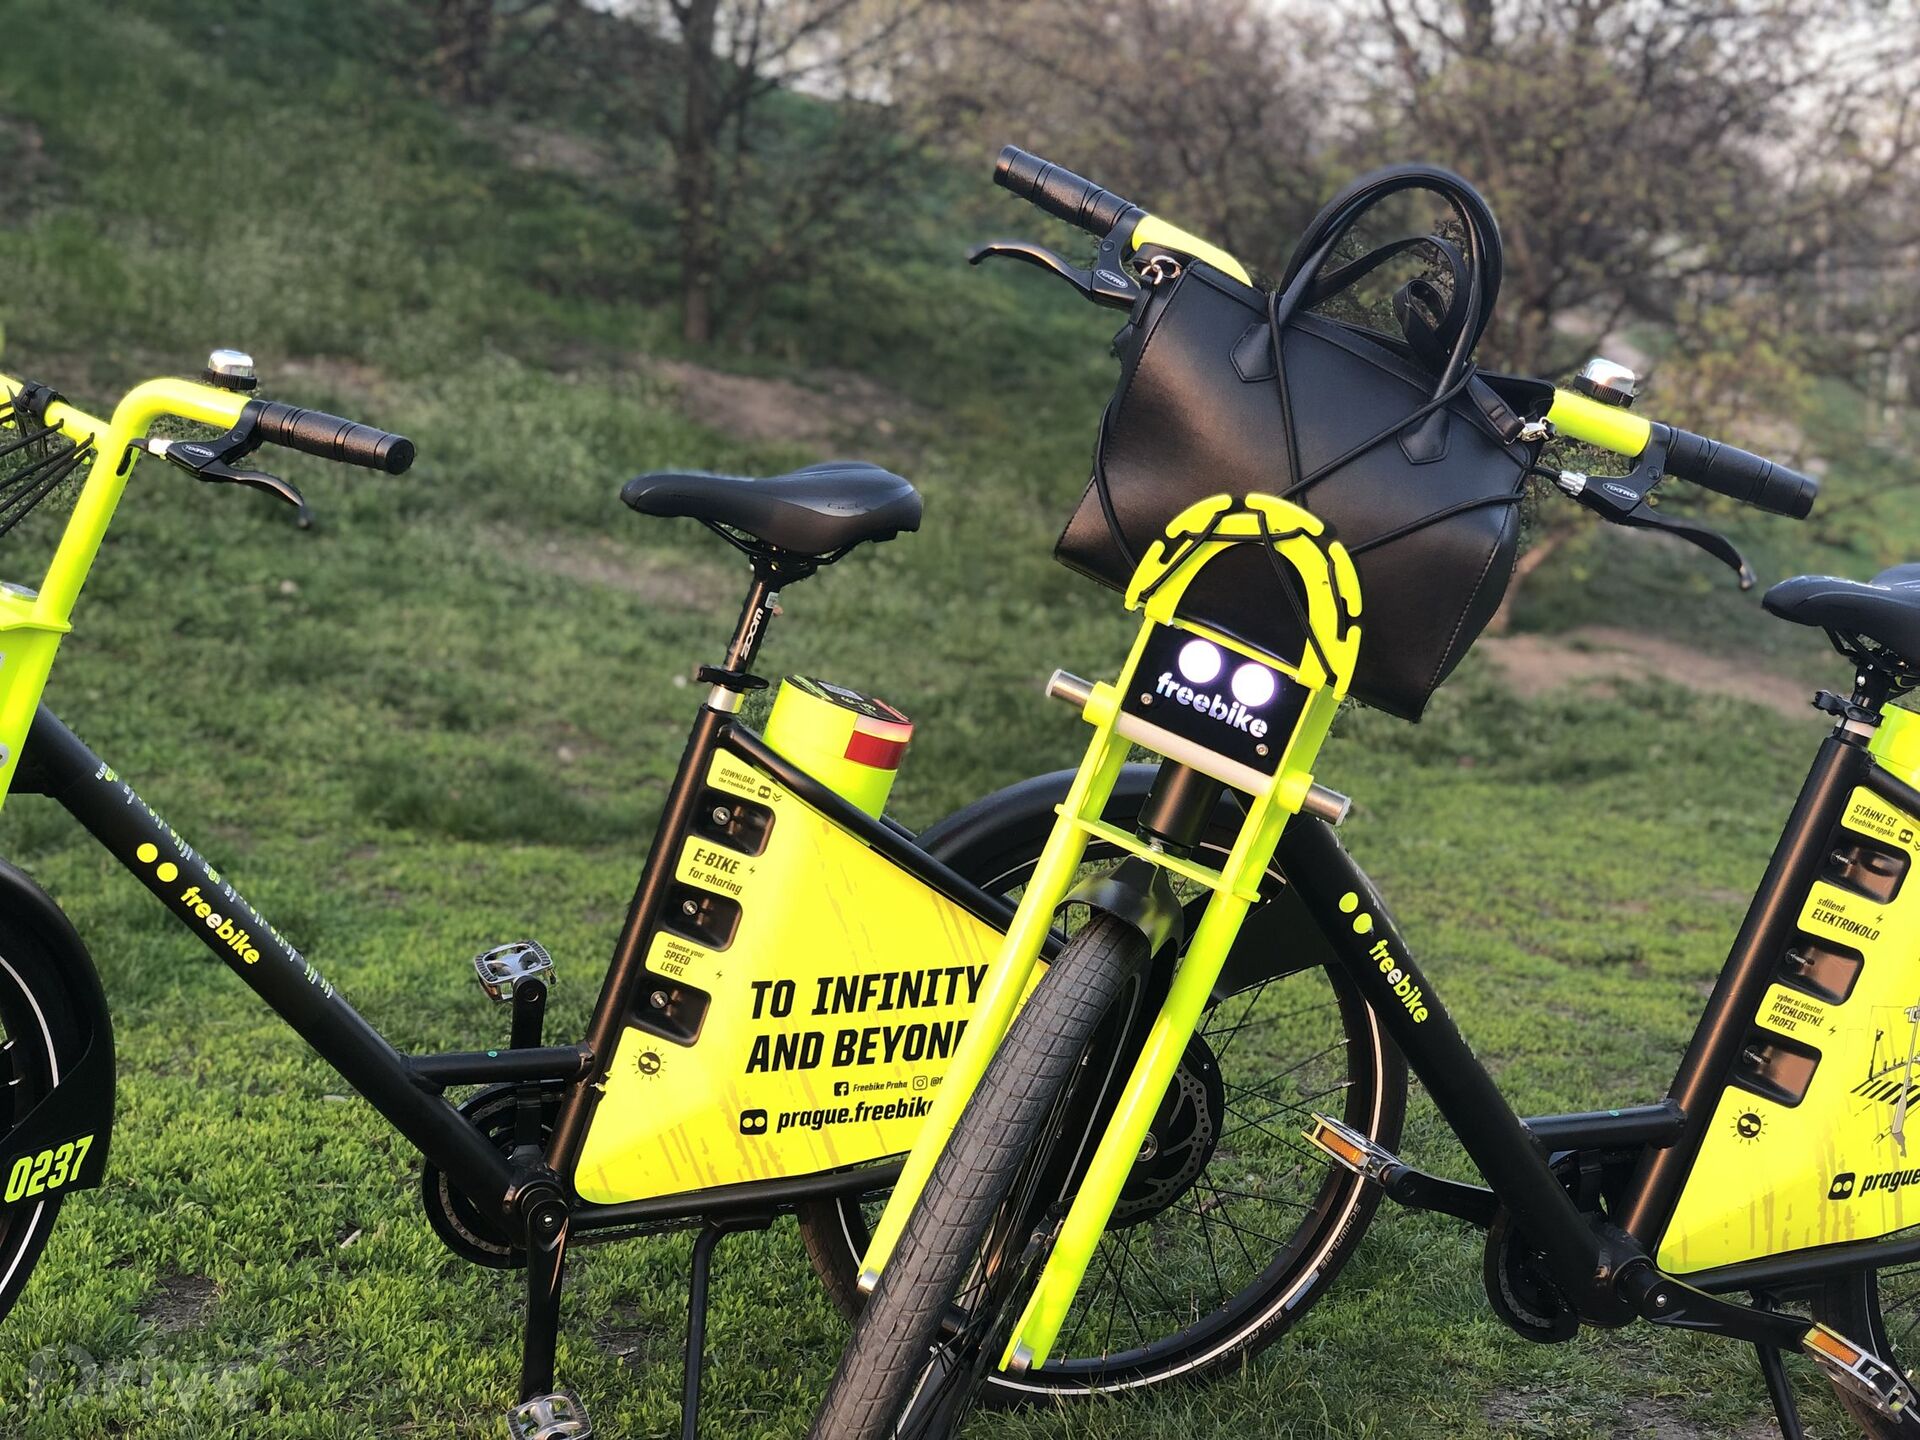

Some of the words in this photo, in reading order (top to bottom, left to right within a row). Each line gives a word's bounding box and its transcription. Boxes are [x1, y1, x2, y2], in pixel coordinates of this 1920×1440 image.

[1155, 672, 1268, 738] freebike
[720, 767, 755, 785] DOWNLOAD
[1849, 815, 1875, 829] freebike
[1885, 816, 1898, 827] SI
[693, 848, 740, 874] E-BIKE
[688, 867, 706, 880] for
[704, 874, 742, 896] sharing
[181, 886, 260, 964] freebike
[1811, 908, 1880, 941] ELEKTROKOLO
[664, 950, 691, 966] SPEED
[667, 942, 690, 953] choose
[689, 949, 704, 959] your
[660, 961, 684, 977] LEVEL
[1369, 939, 1428, 1023] freebike
[751, 979, 796, 1020] TO
[811, 964, 989, 1016] INFINITY
[1767, 1014, 1797, 1031] PROFIL
[745, 1031, 824, 1074] AND
[853, 1082, 884, 1092] Freebike
[886, 1080, 908, 1090] Praha
[776, 1096, 934, 1133] prague.freebik
[4, 1134, 94, 1203] 0237
[1858, 1168, 1920, 1198] prague
[1319, 1202, 1362, 1270] SCHWALBE
[1263, 1311, 1283, 1331] BIG
[1220, 1329, 1260, 1360] APPLE
